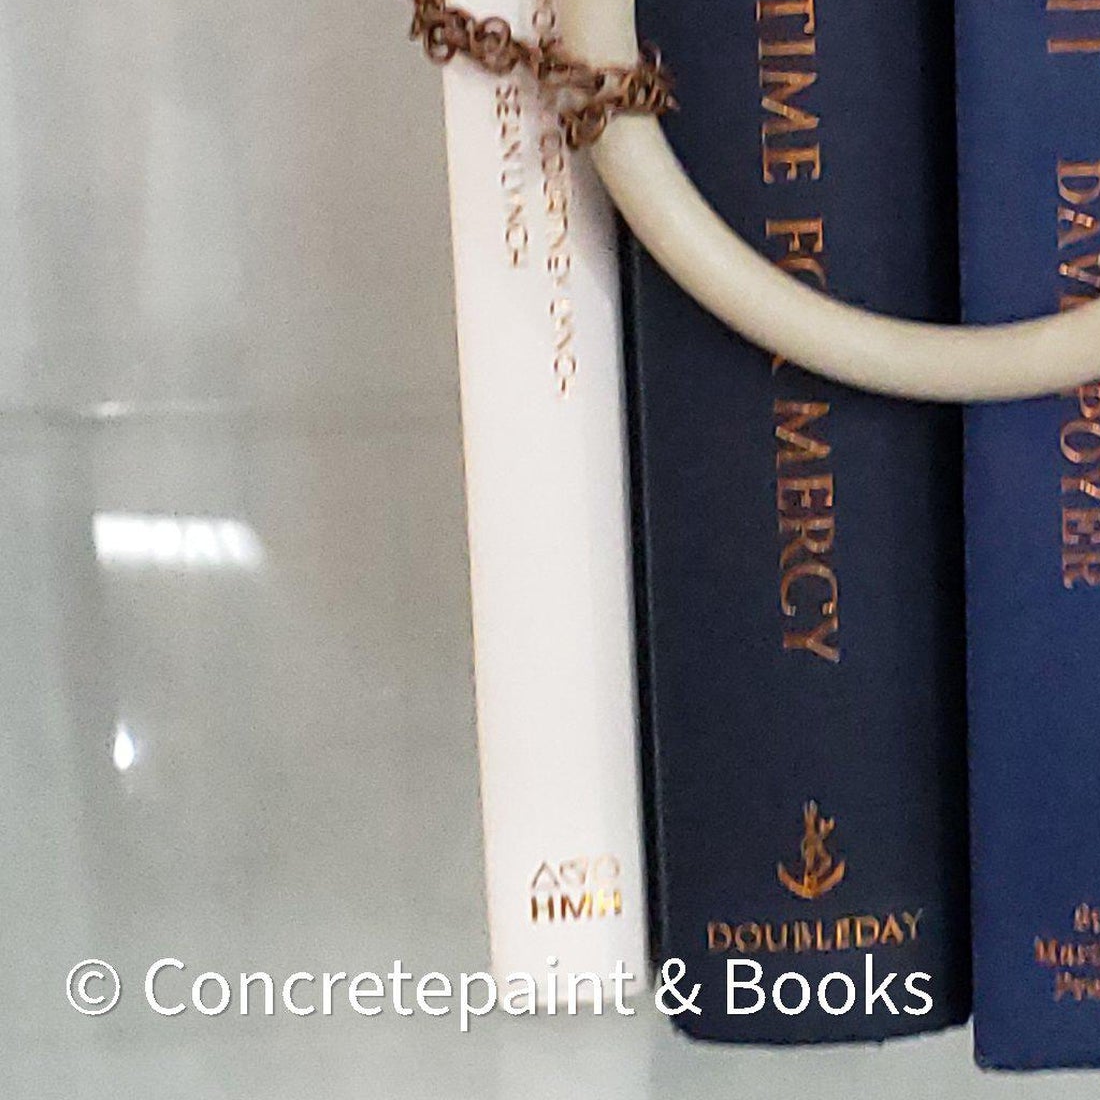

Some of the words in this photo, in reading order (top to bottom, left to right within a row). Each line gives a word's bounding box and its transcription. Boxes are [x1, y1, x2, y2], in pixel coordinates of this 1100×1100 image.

[773, 399, 840, 664] MERCY
[531, 889, 622, 923] HMH
[706, 907, 923, 953] DOUBLEDAY
